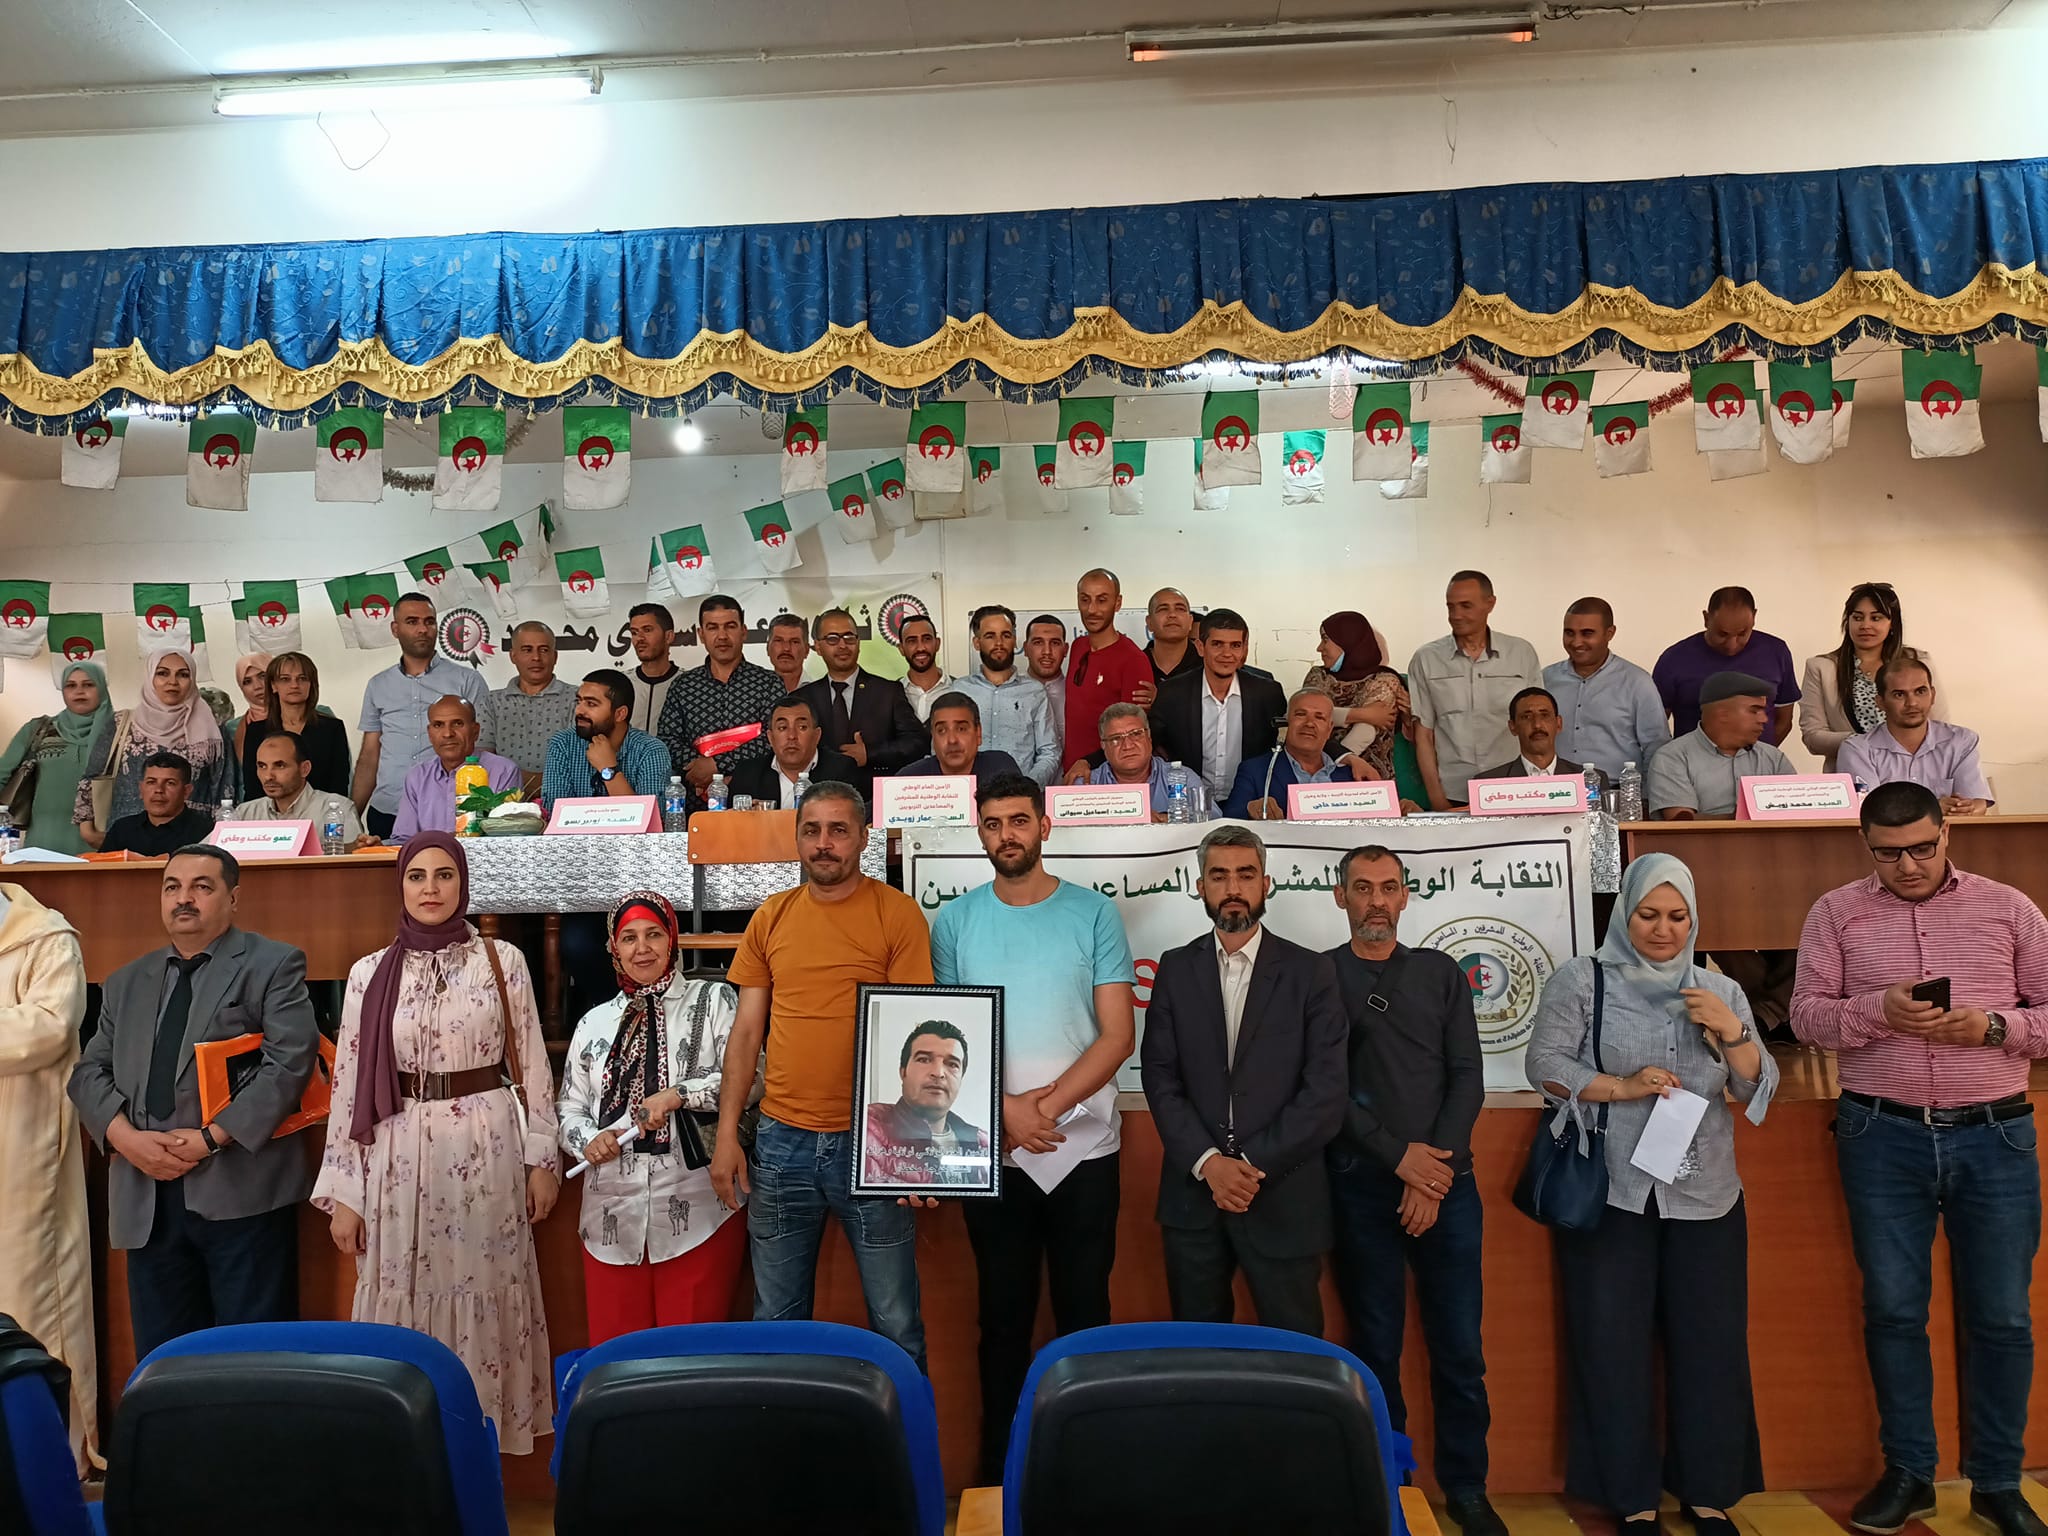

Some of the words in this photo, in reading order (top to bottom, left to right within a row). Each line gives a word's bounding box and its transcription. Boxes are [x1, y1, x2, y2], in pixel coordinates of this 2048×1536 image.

[1485, 792, 1514, 803] وطني
[1516, 790, 1546, 800] مكتب
[1548, 790, 1571, 800] عضو
[246, 834, 272, 842] مكتب
[272, 834, 293, 844] عضو
[1266, 864, 1342, 899] للمشر
[1403, 865, 1455, 900] الوط
[1470, 859, 1564, 898] النقابة
